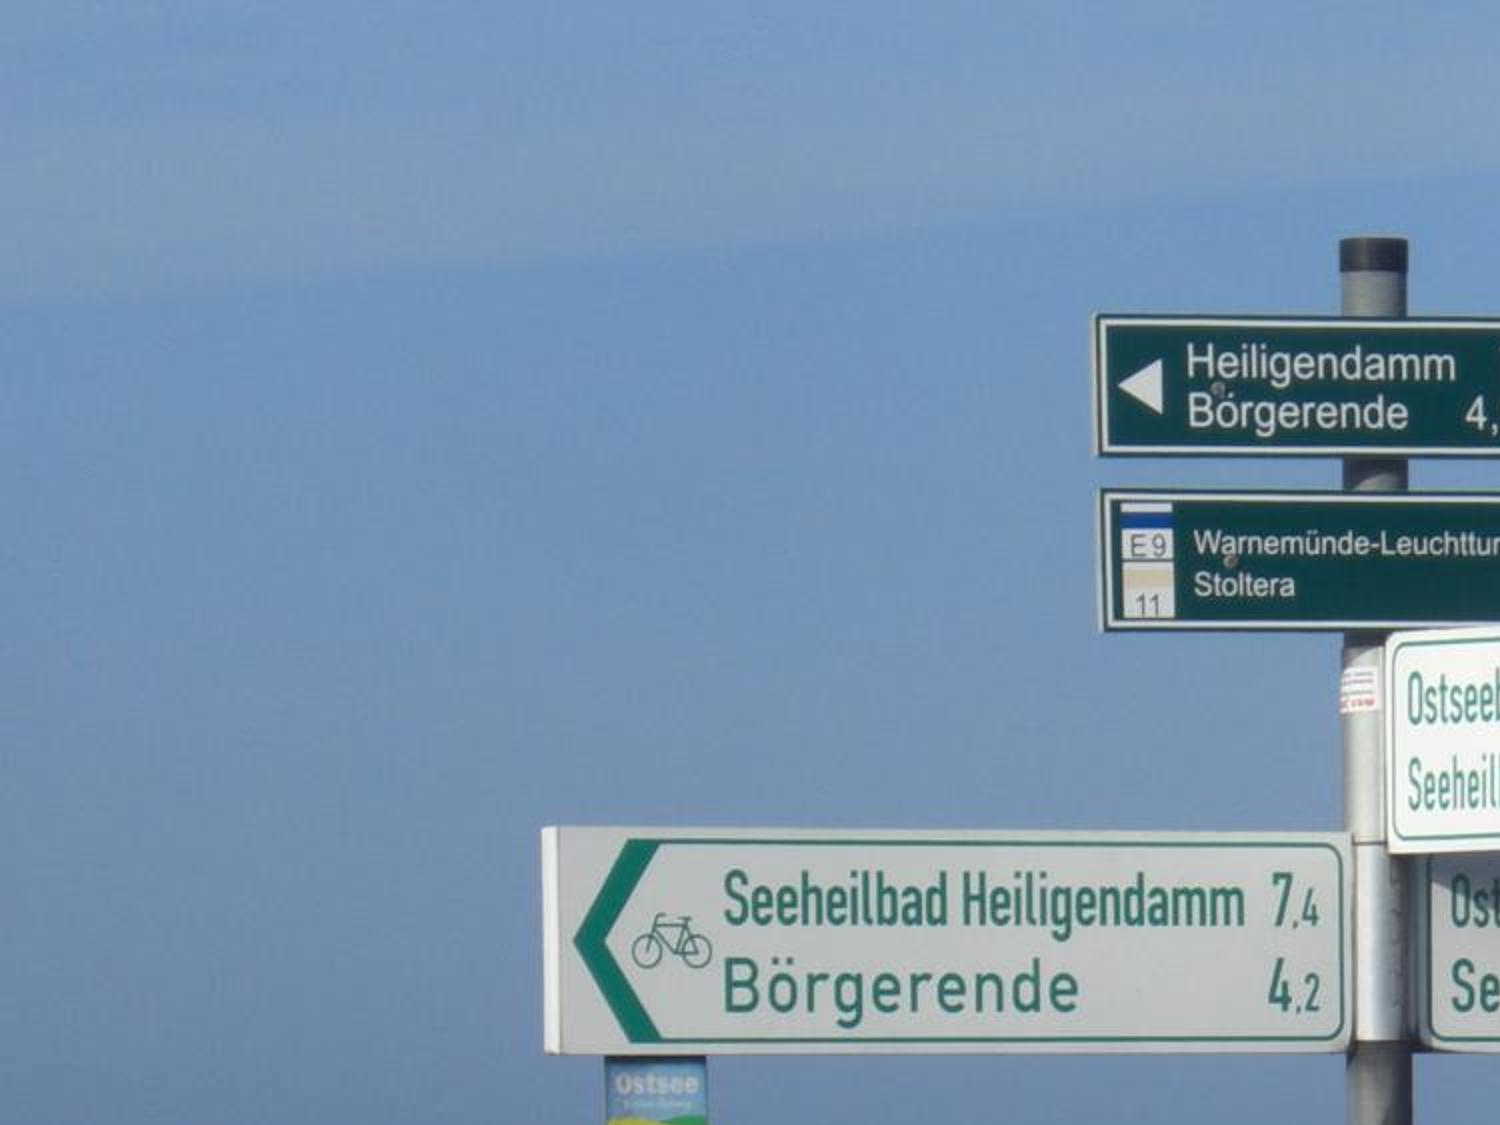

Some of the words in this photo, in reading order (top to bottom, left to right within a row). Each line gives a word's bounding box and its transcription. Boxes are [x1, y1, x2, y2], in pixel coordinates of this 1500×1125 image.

[1186, 342, 1456, 388] Heiligendamm
[1188, 391, 1409, 437] Börgerende
[1136, 593, 1161, 616] 11
[1193, 571, 1296, 598] Stoltera
[723, 868, 947, 927] Seeheilbad
[962, 870, 1245, 942] Heiligendamm
[1272, 872, 1319, 929] 7,4
[723, 956, 1078, 1029] Börgerende
[1268, 957, 1321, 1014] 4,2
